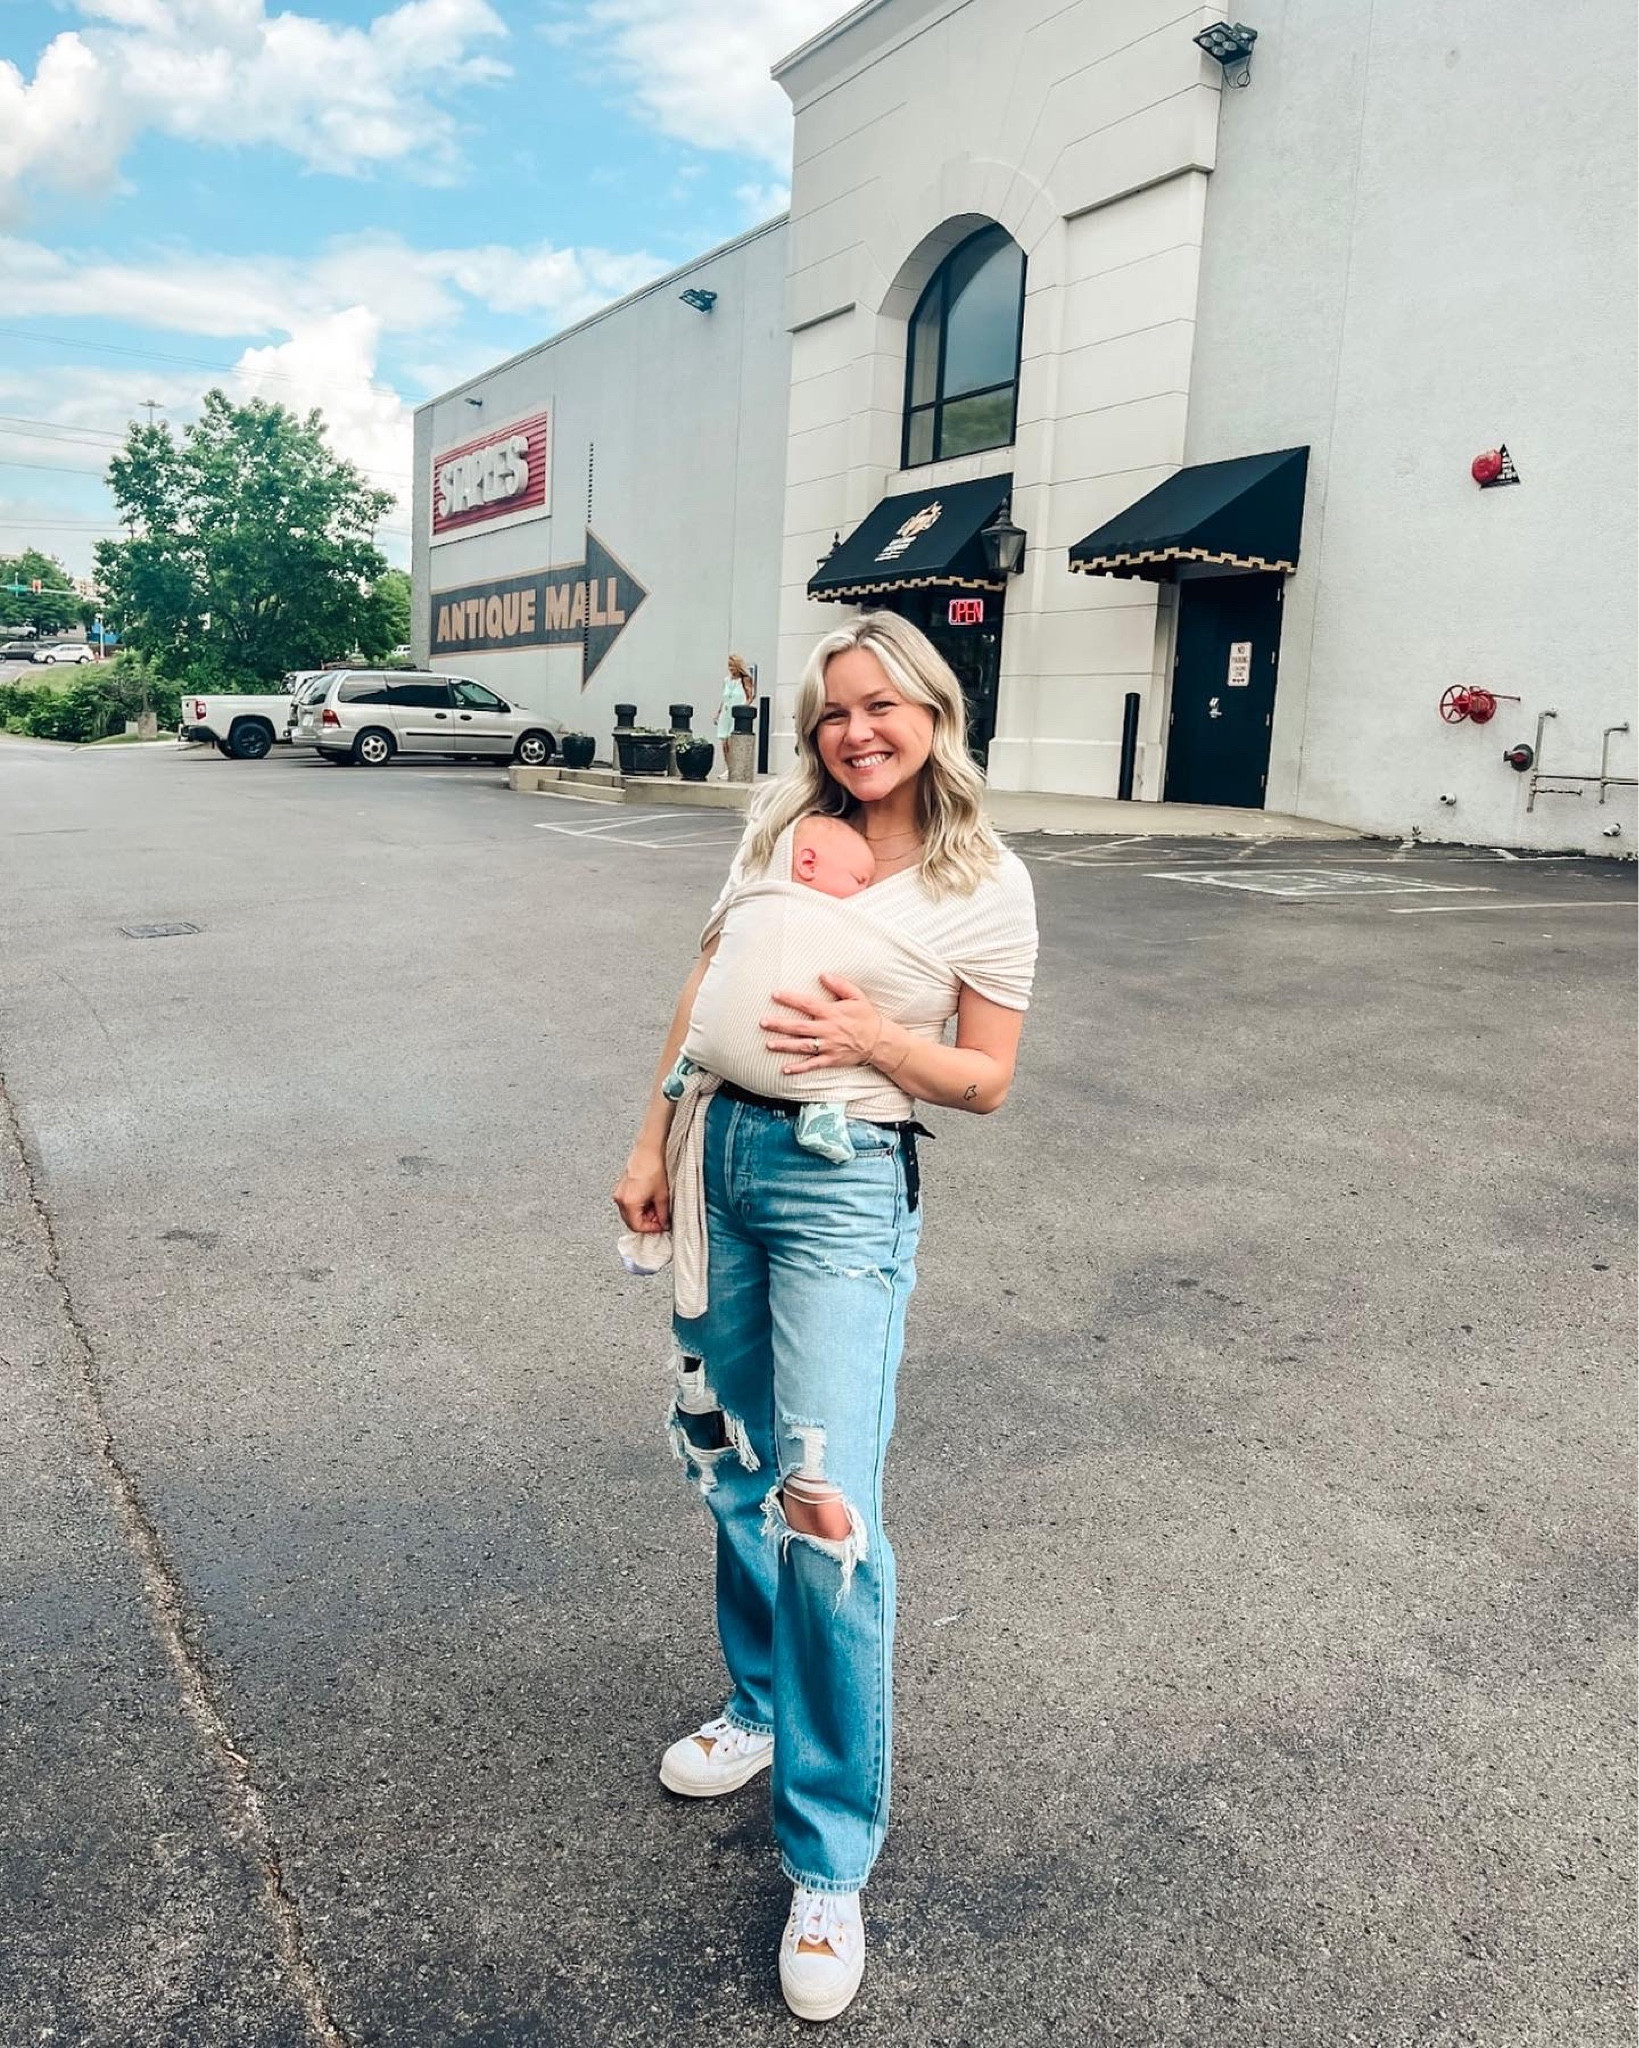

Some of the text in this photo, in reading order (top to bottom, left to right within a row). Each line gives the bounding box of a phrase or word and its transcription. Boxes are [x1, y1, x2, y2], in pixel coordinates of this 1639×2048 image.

[437, 577, 625, 642] ANTIQUE MALL
[950, 600, 983, 623] OPEN
